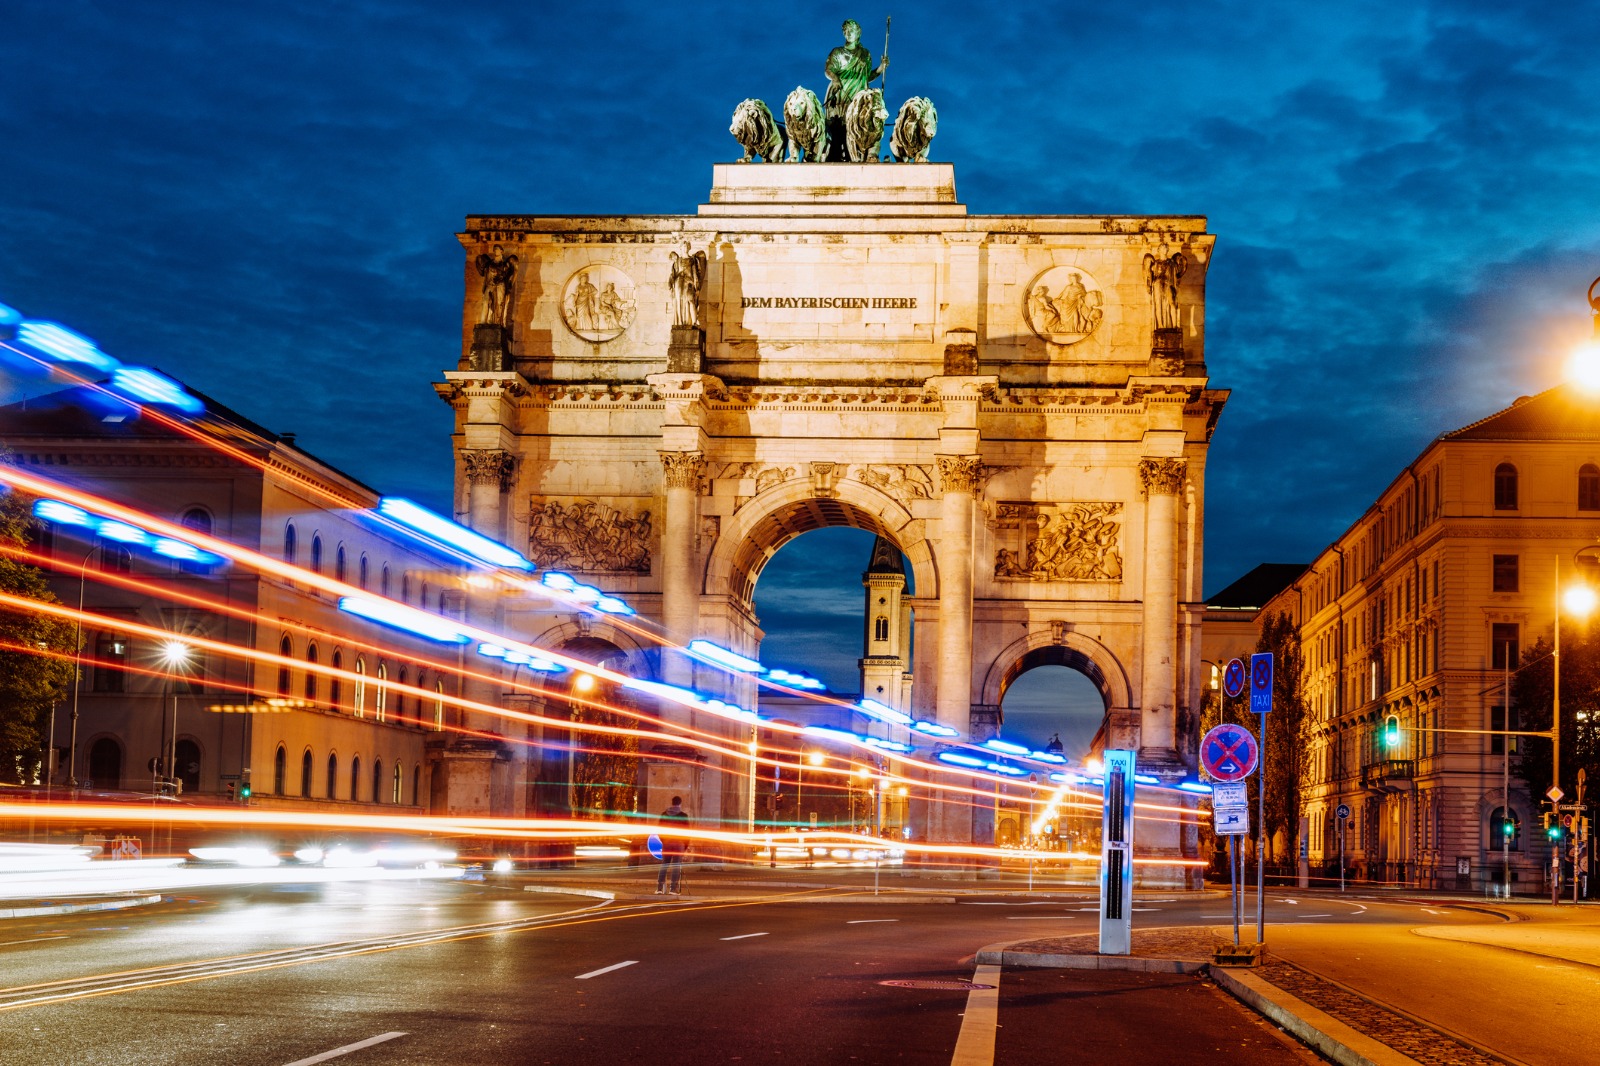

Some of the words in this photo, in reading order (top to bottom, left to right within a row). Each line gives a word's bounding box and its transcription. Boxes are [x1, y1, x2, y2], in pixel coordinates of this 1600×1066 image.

[741, 297, 772, 308] DEM
[774, 297, 869, 308] BAYERISCHEN
[872, 297, 917, 308] HEERE
[1253, 694, 1270, 706] TAXI
